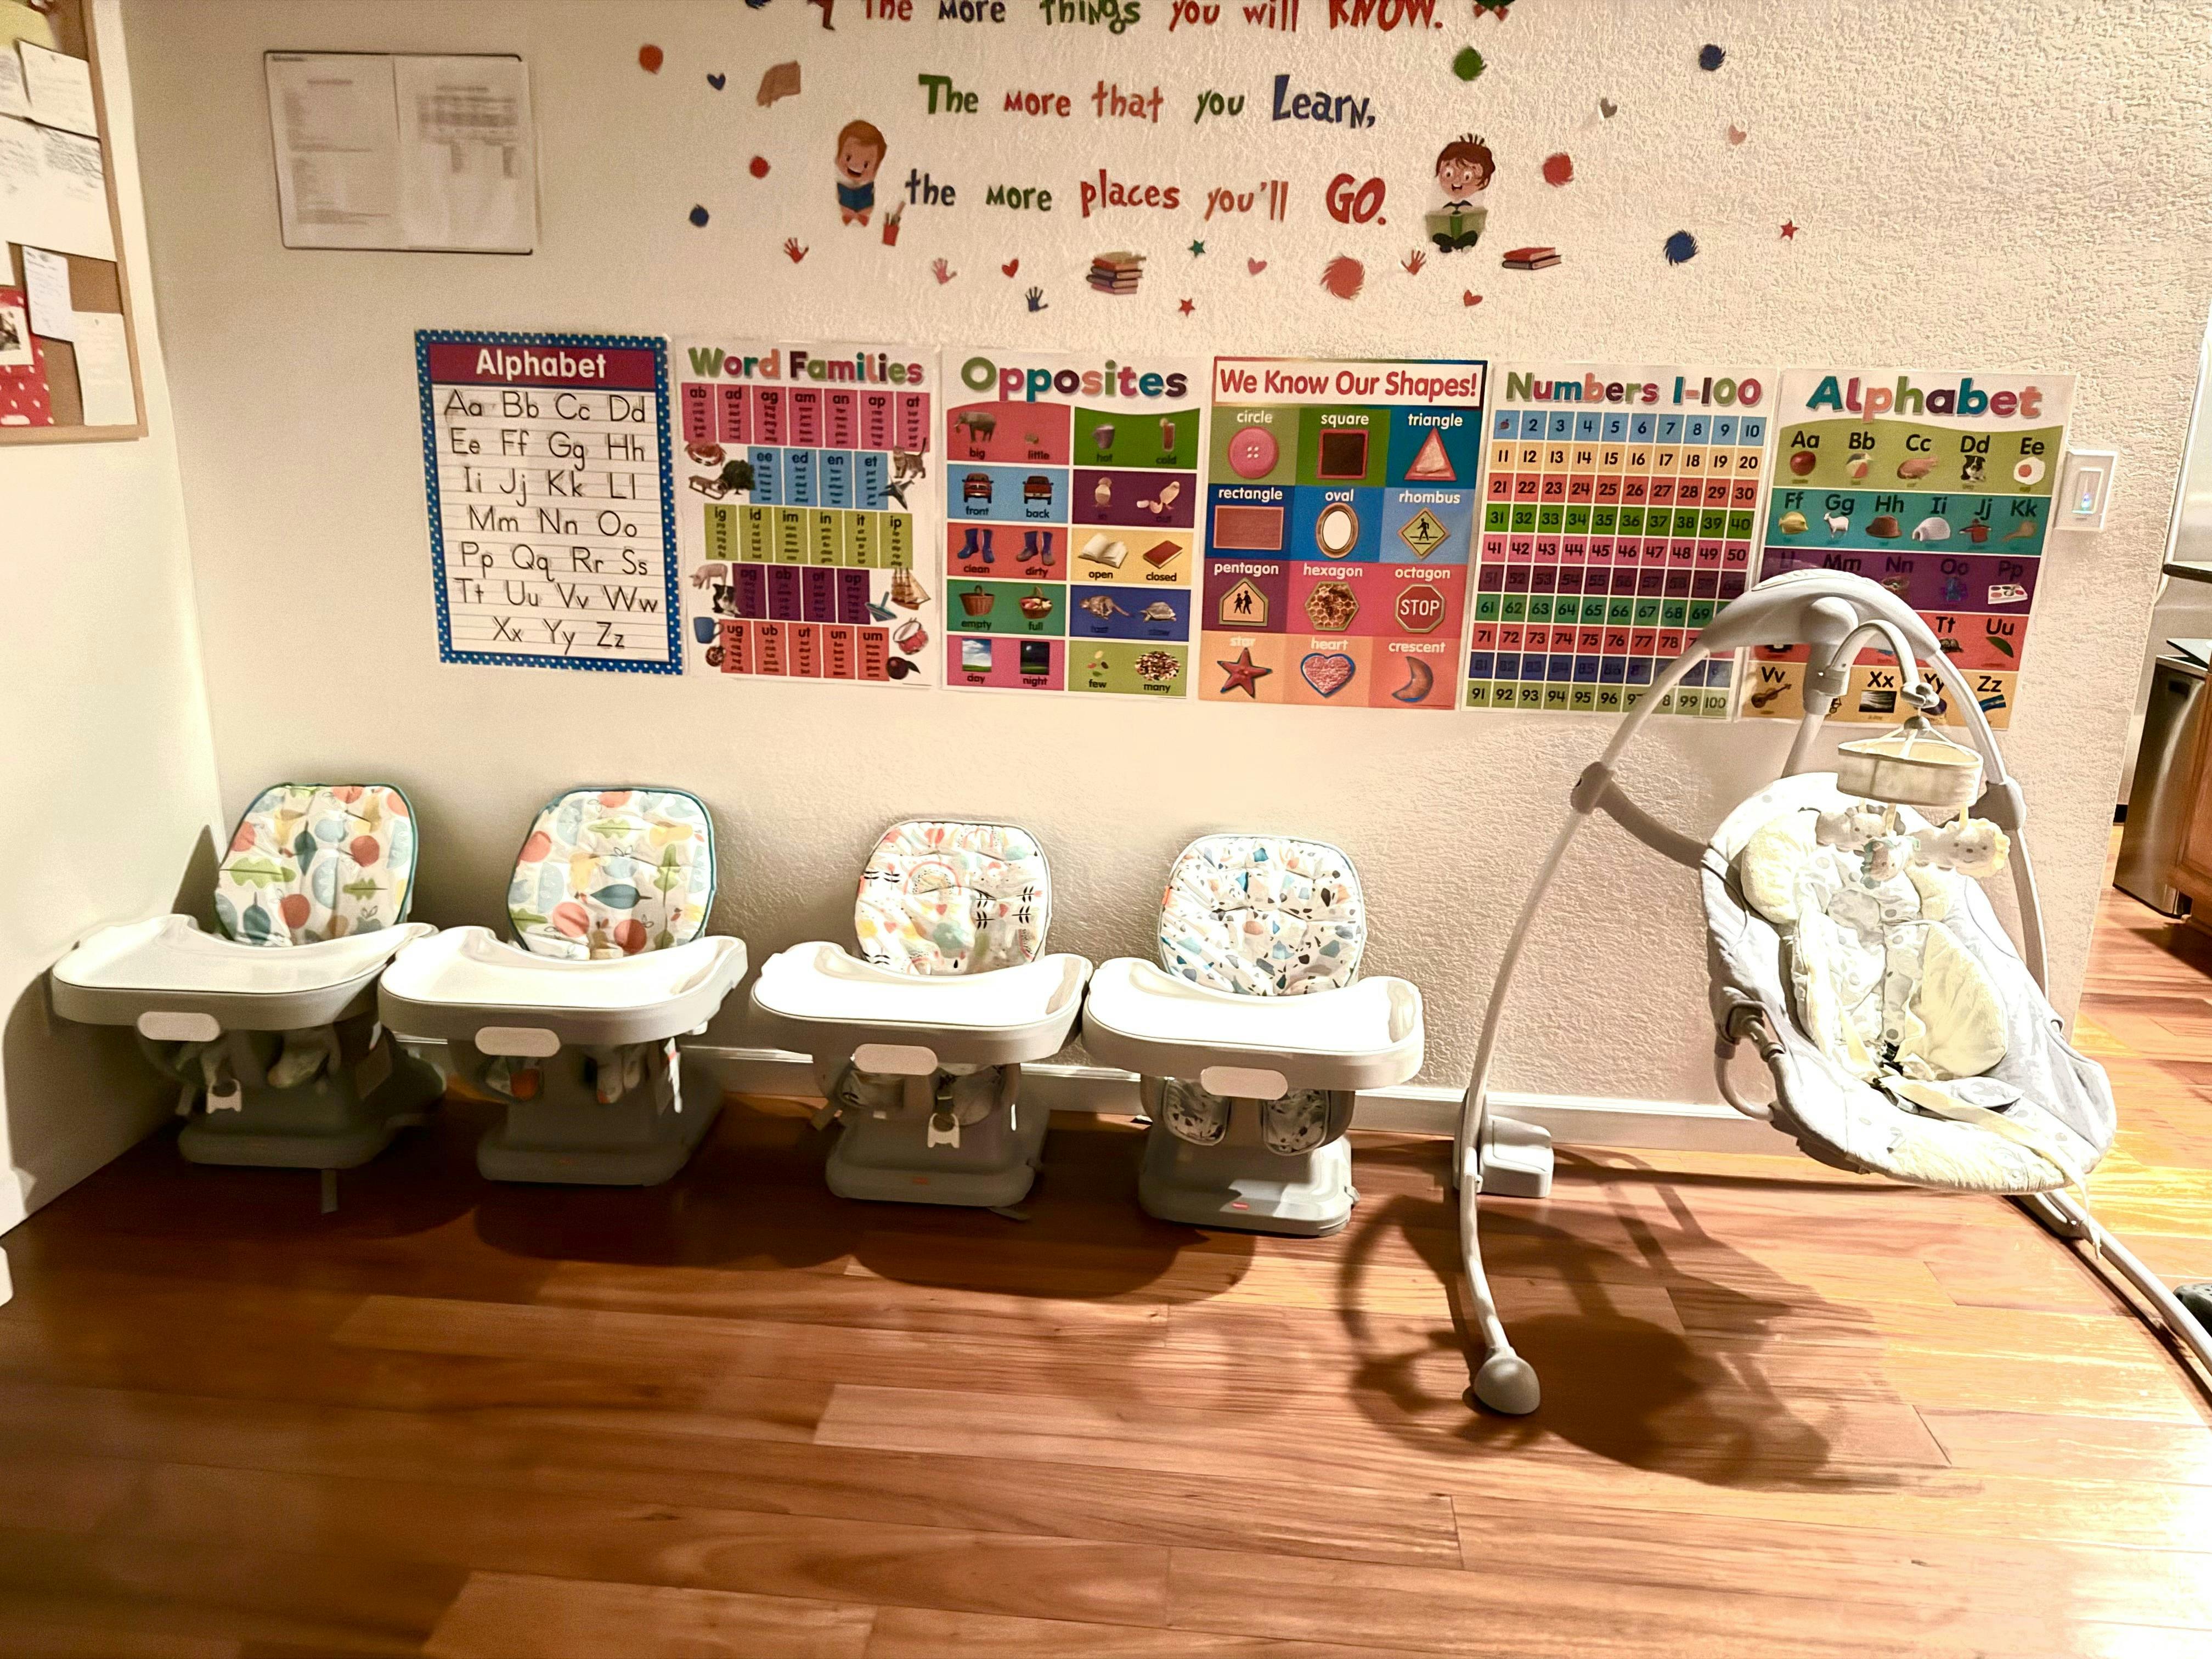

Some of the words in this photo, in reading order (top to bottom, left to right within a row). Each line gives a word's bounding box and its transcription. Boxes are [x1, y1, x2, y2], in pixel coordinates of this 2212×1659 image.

[1169, 0, 1220, 31] you
[1244, 0, 1299, 32] will
[1329, 0, 1443, 31] KNOW.
[918, 74, 978, 114] The
[1091, 81, 1164, 123] that
[1194, 89, 1245, 125] you
[905, 168, 956, 206] the
[1081, 169, 1180, 218] places
[1204, 180, 1289, 222] you'll
[1326, 173, 1386, 225] GO.
[476, 349, 606, 381] Alphabet
[688, 347, 781, 380] Word
[789, 351, 924, 385] Families
[961, 357, 1187, 403] Opposites
[1220, 369, 1257, 393] We
[1265, 370, 1329, 394] Know
[1335, 371, 1380, 395] Our
[1385, 371, 1477, 403] Shapes!
[1506, 371, 1658, 403] Numbers
[1673, 376, 1762, 407] 1-100
[444, 389, 482, 416] Aa
[503, 391, 539, 418] Bb
[555, 393, 590, 420] Cc
[607, 394, 645, 422] Dd
[690, 387, 706, 398] ab
[725, 387, 742, 399] ad
[761, 391, 778, 404] ag
[795, 392, 815, 403] am
[833, 394, 850, 405] an
[868, 396, 885, 408] ap
[907, 396, 919, 407] at
[1805, 376, 2042, 424] Alphabet
[1237, 410, 1272, 424] circle
[1321, 414, 1369, 427] square
[1408, 413, 1463, 429] triangle
[1528, 420, 1537, 431] 2
[1556, 420, 1565, 432] 3
[1583, 420, 1592, 433] 4
[1611, 421, 1620, 433] 5
[1638, 421, 1647, 433] 6
[1666, 422, 1675, 434] 7
[1693, 423, 1701, 435] 8
[1721, 425, 1729, 436] 9
[1746, 425, 1759, 437] 10
[450, 427, 480, 454] Ee
[501, 430, 529, 455] Ff
[549, 431, 585, 471] Gg
[607, 433, 644, 461] Hh
[1791, 431, 1819, 449] Aa
[1849, 432, 1875, 450] Bb
[1906, 435, 1931, 452] Cc
[1960, 435, 1989, 453] Dd
[2020, 437, 2045, 455] Ee
[757, 452, 772, 462] ee
[792, 452, 808, 464] ed
[828, 455, 843, 465] en
[865, 455, 877, 466] et
[969, 447, 985, 460] big
[1028, 450, 1049, 460] little
[1097, 453, 1112, 463] hot
[1156, 455, 1177, 465] cold
[1498, 450, 1508, 462] 11
[1523, 450, 1536, 462] 12
[1550, 450, 1564, 463] 13
[1577, 452, 1591, 464] 14
[1605, 452, 1618, 464] 15
[1632, 452, 1645, 465] 16
[1659, 454, 1673, 466] 17
[1687, 454, 1700, 466] 18
[1714, 455, 1727, 468] 19
[1739, 456, 1758, 469] 20
[465, 466, 482, 493] Ii
[500, 468, 527, 507] Jj
[548, 469, 583, 496] Kk
[610, 472, 635, 499] Ll
[1218, 487, 1283, 503] rectangle
[1325, 489, 1354, 502] oval
[1399, 490, 1460, 504] rhombus
[1785, 493, 1804, 509] Ff
[1825, 495, 1855, 515] Gg
[1875, 495, 1904, 512] Hh
[1931, 496, 1946, 514] Ii
[1973, 499, 1992, 520] Jj
[2010, 499, 2038, 517] Kk
[469, 505, 518, 532] Mm
[538, 507, 578, 534] Nn
[599, 510, 637, 537] Oo
[715, 507, 726, 521] ig
[749, 509, 761, 521] id
[783, 510, 799, 522] im
[820, 512, 831, 524] in
[856, 514, 865, 526] it
[890, 516, 901, 529] ip
[966, 505, 990, 516] front
[1026, 508, 1049, 518] back
[461, 541, 493, 579] Pp
[512, 544, 555, 582] Qq
[572, 546, 603, 573] Rr
[622, 549, 647, 575] Ss
[963, 564, 990, 574] clean
[1025, 566, 1048, 578] dirty
[1214, 562, 1279, 578] pentagon
[1304, 563, 1363, 578] hexagon
[1886, 556, 1914, 573] Nn
[1940, 558, 1969, 575] Oo
[1088, 569, 1113, 580] open
[1146, 572, 1177, 582] closed
[1395, 567, 1451, 582] octagon
[454, 578, 484, 603] Tt
[506, 580, 539, 606] Uu
[557, 583, 589, 609] Vv
[603, 585, 657, 612] Ww
[1400, 600, 1440, 616] STOP
[727, 625, 743, 637] ug
[761, 624, 778, 636] ub
[798, 627, 810, 637] ut
[831, 629, 847, 640] un
[863, 631, 883, 641] um
[961, 620, 992, 631] empty
[1029, 620, 1043, 631] full
[1936, 617, 1956, 633] Tt
[1986, 619, 2015, 636] Uu
[494, 617, 522, 642] Xx
[543, 619, 575, 655] Yy
[597, 622, 625, 647] Zz
[1229, 635, 1255, 647] star
[1311, 637, 1348, 651] heart
[1389, 641, 1446, 653] crescent
[967, 674, 985, 684] day
[1023, 675, 1047, 687] night
[1088, 678, 1107, 689] few
[1143, 682, 1171, 692] many
[1762, 667, 1785, 683] Vv
[1867, 671, 1895, 687] Xx
[1977, 675, 2002, 692] Zz
[1472, 687, 1485, 699] 91
[1522, 689, 1538, 701] 93
[1575, 691, 1591, 703] 95
[1601, 692, 1617, 704] 96
[1680, 695, 1697, 708] 99
[1705, 696, 1725, 709] 100
